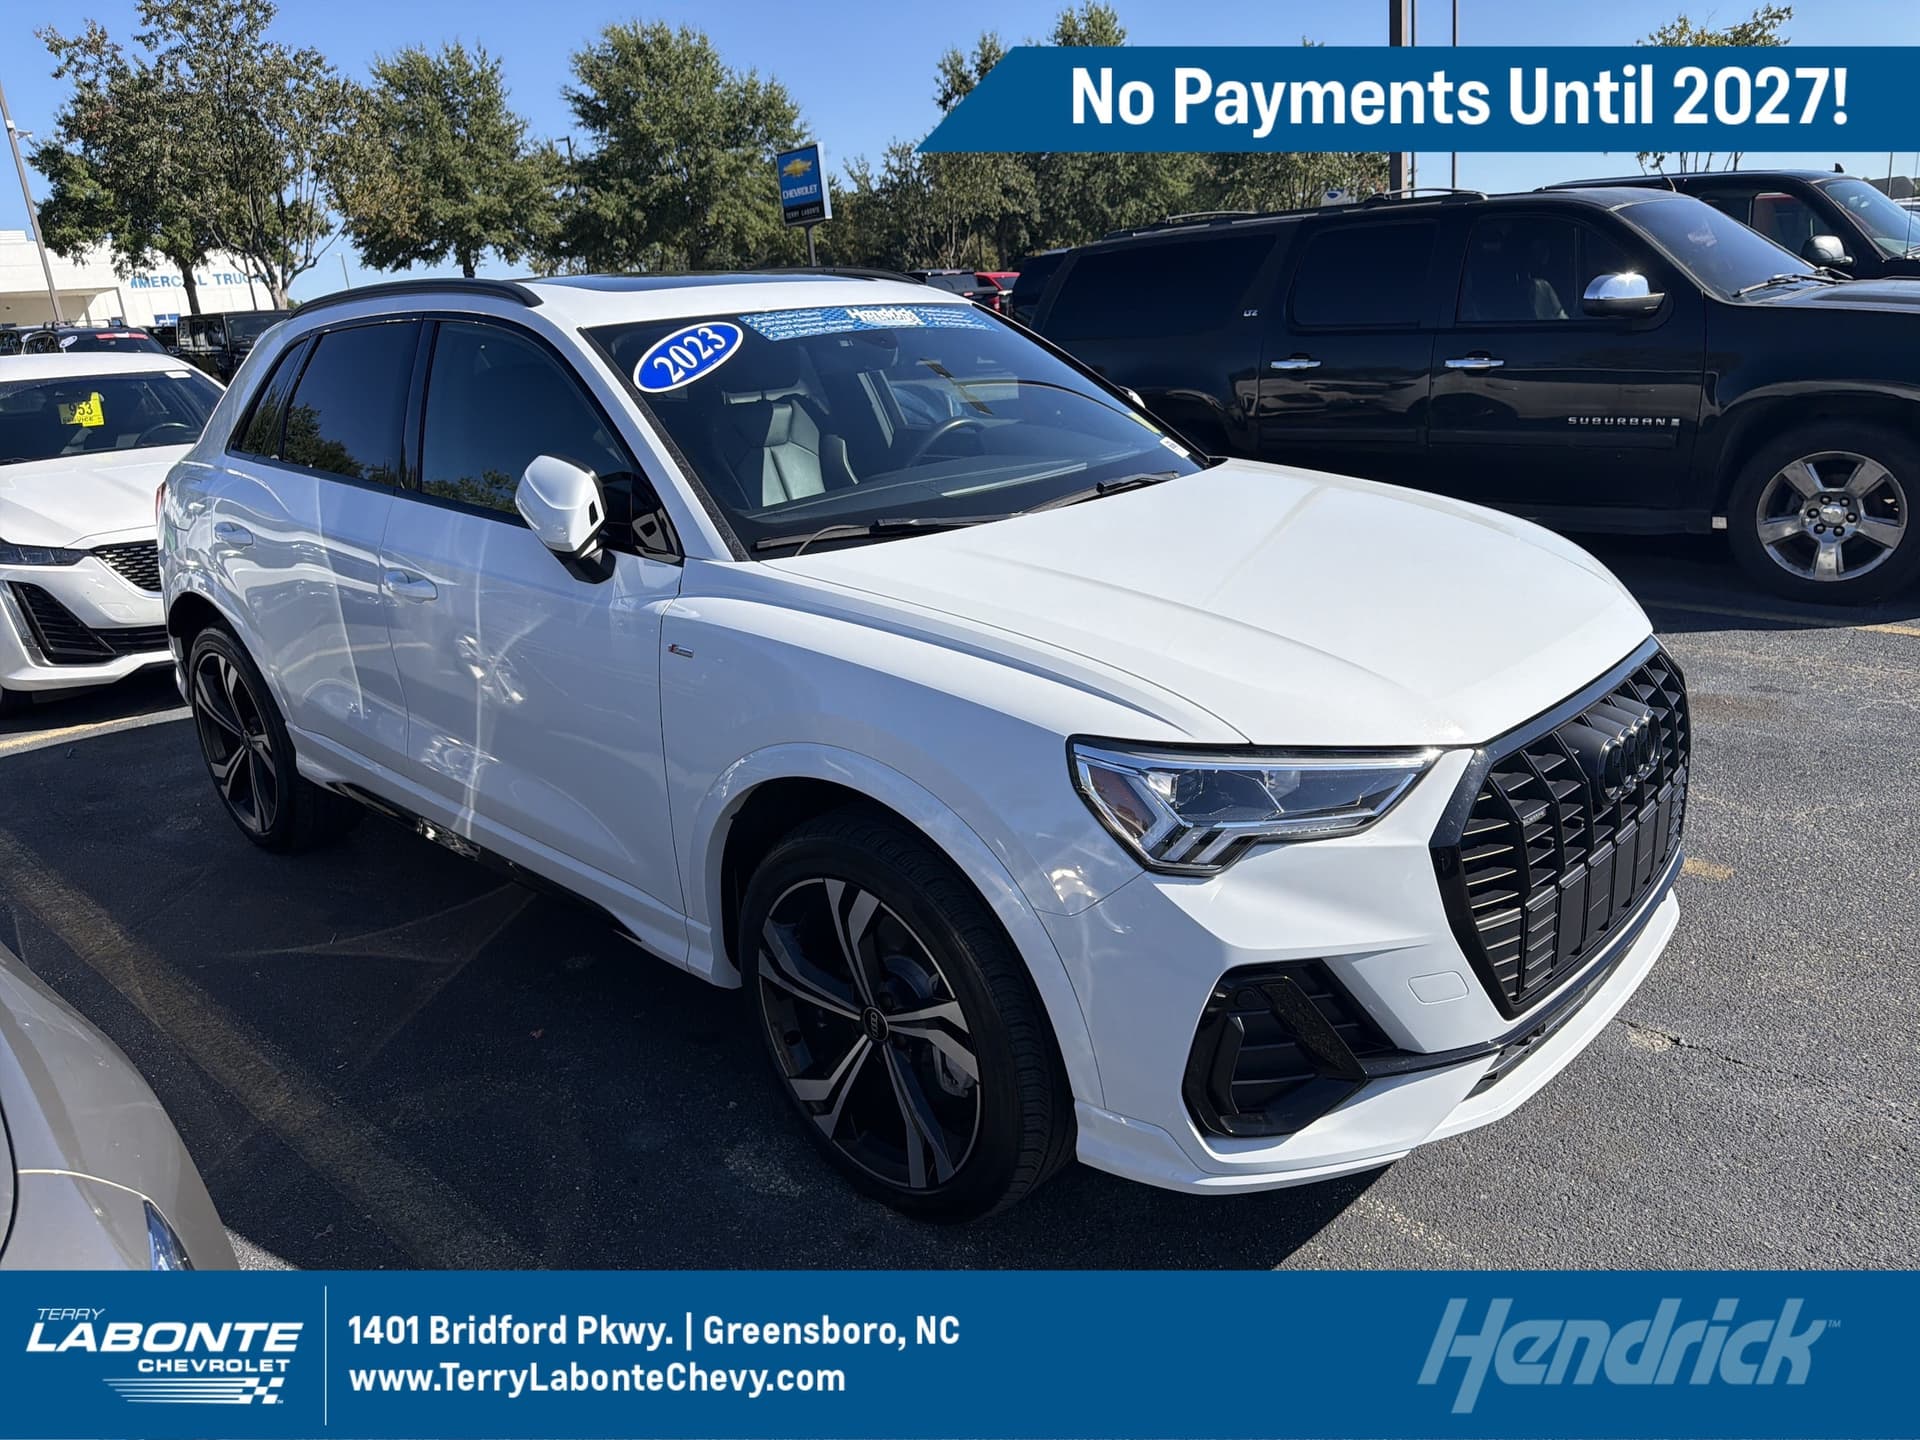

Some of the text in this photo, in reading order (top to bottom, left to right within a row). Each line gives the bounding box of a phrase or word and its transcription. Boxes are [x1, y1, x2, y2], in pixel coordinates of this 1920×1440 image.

[782, 184, 817, 200] CHEVROLET
[653, 327, 726, 384] 2023
[69, 400, 94, 418] 953
[1567, 416, 1666, 426] SUBURBAN
